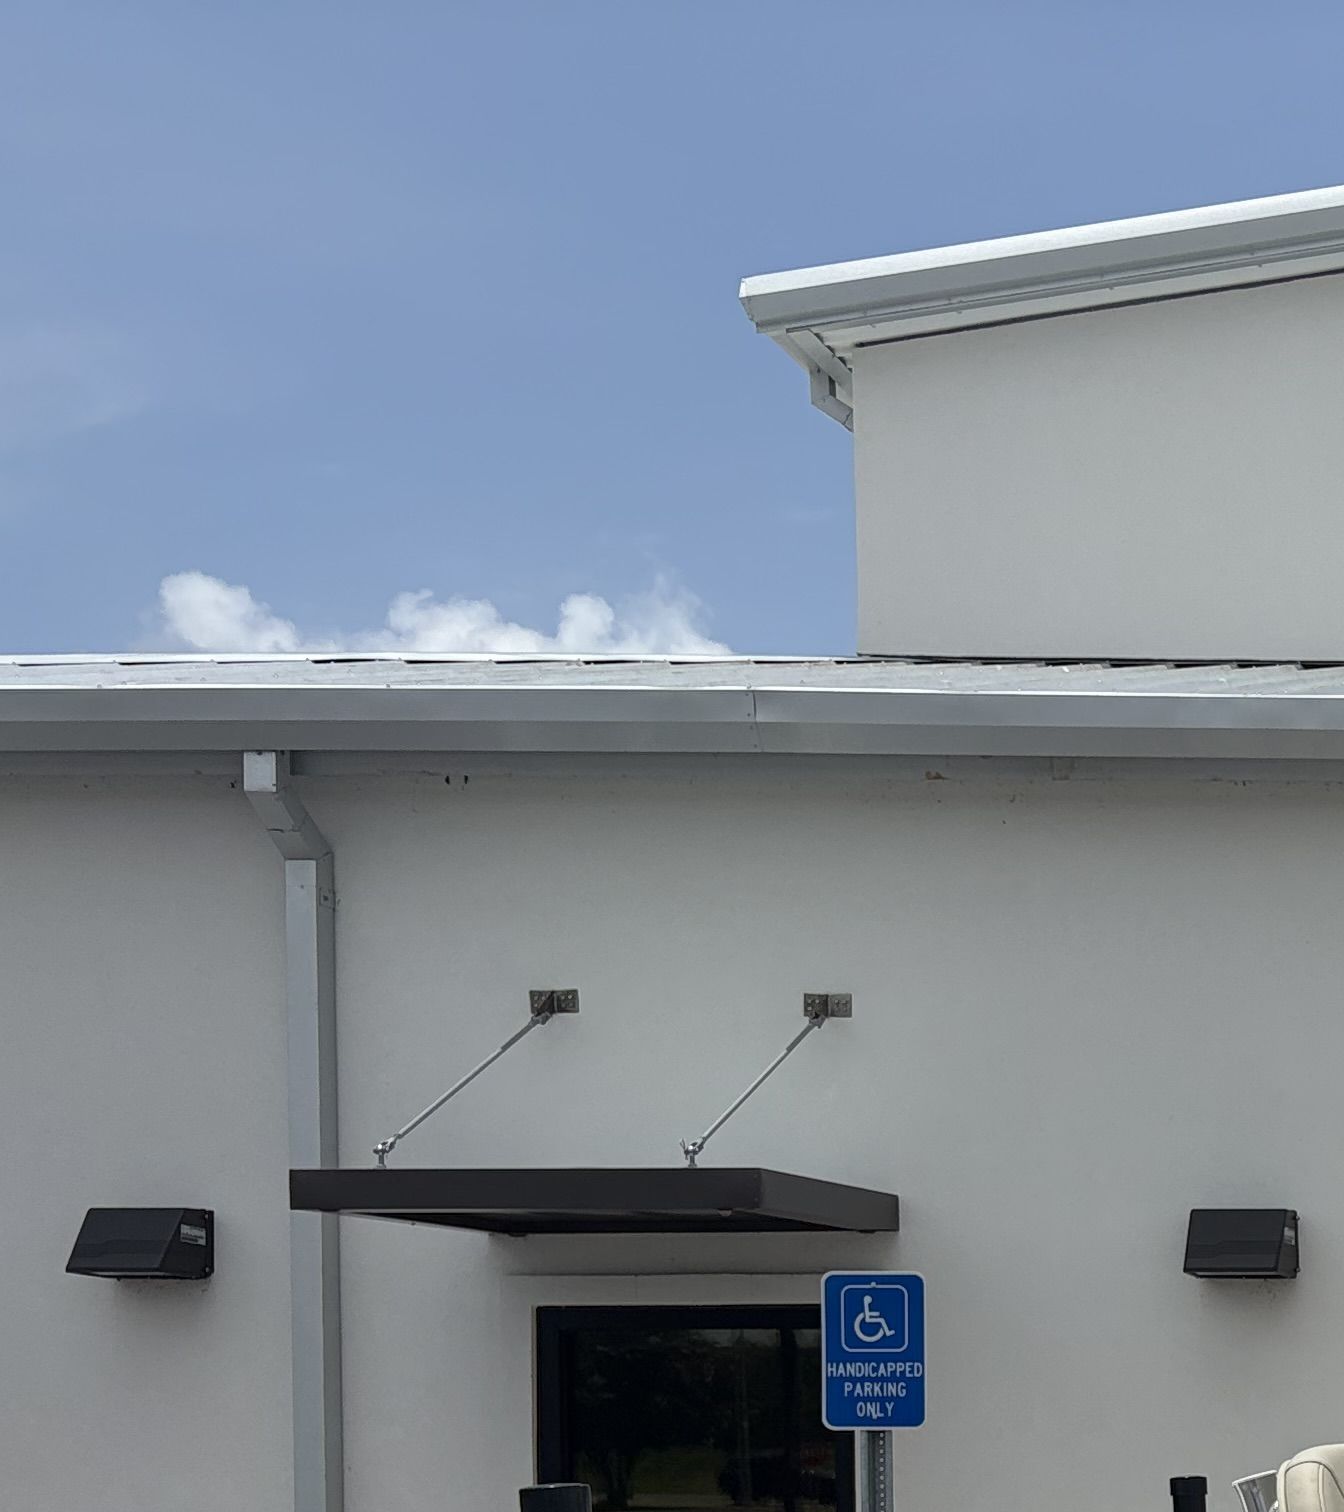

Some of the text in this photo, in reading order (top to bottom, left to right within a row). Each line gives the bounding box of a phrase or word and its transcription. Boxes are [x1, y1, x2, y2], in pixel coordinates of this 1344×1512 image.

[827, 1362, 923, 1378] HANDICAPPED
[844, 1382, 907, 1398] PARKING
[856, 1402, 895, 1418] ONLY
